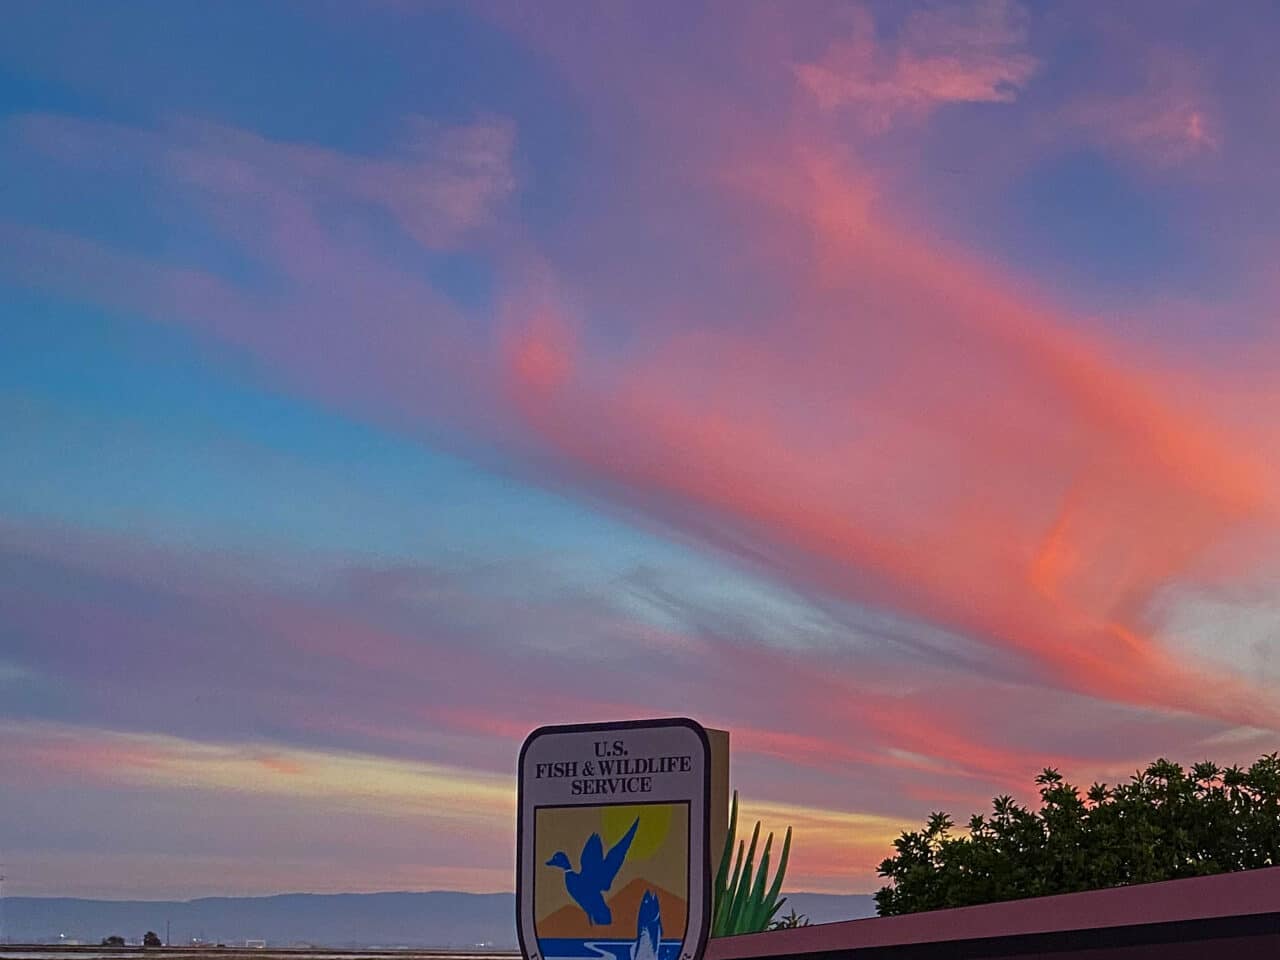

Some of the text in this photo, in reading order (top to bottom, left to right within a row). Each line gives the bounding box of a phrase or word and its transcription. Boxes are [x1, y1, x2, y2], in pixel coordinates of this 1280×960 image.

[594, 741, 628, 757] U.S.
[536, 756, 691, 778] FISH & WILDLIFE
[571, 776, 652, 795] SERVICE
